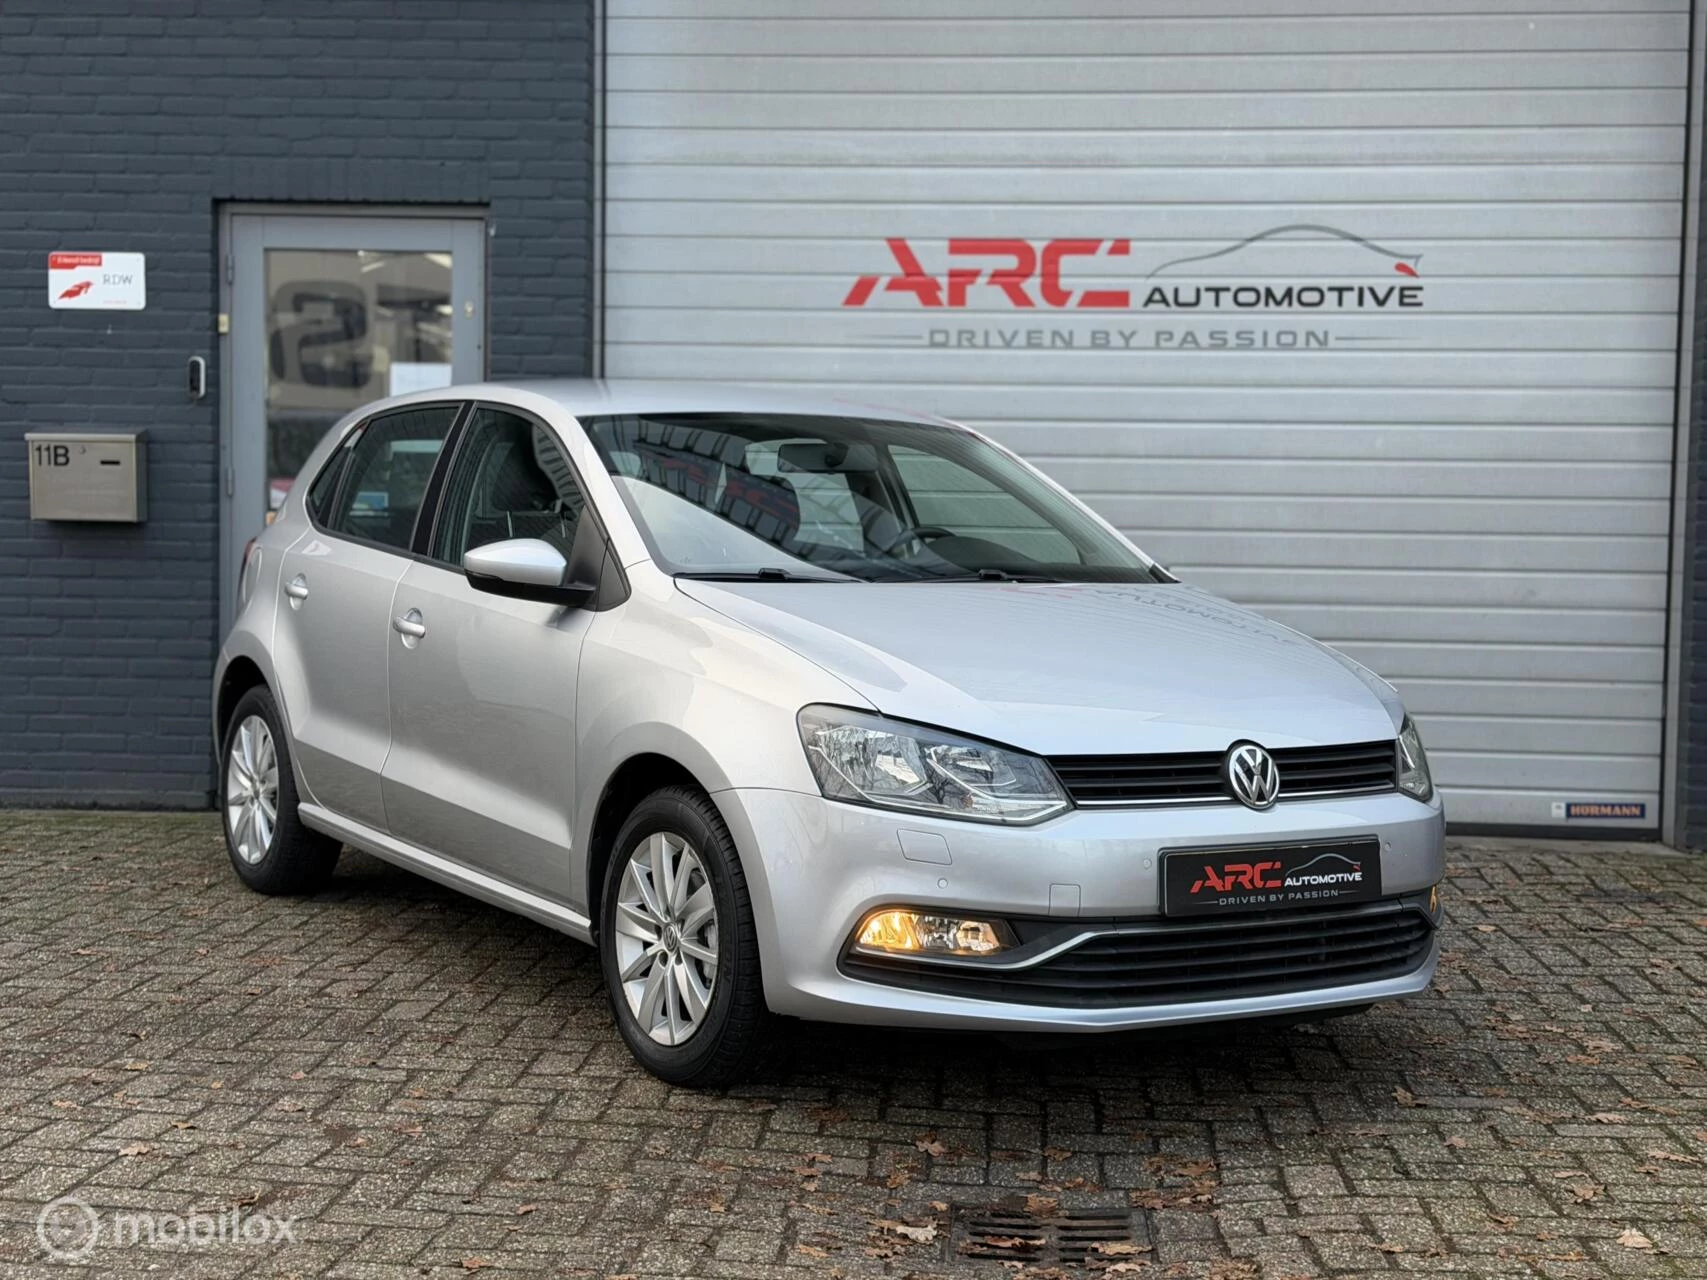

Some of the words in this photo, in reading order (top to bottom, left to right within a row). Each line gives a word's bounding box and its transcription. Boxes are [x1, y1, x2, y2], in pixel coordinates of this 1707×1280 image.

[103, 274, 133, 285] RDW
[843, 238, 1131, 308] ARC
[1142, 285, 1424, 308] AUTOMOTIVE
[928, 329, 1087, 349] DRIVEN
[1091, 329, 1138, 348] BY
[1154, 329, 1330, 348] PASSION
[35, 444, 70, 467] 11B
[1190, 861, 1282, 893] ARC
[1284, 872, 1363, 887] AUTOMOTIVE
[1219, 895, 1266, 905] DRIVEN
[1269, 894, 1285, 902] BY
[1288, 889, 1339, 900] PASSION
